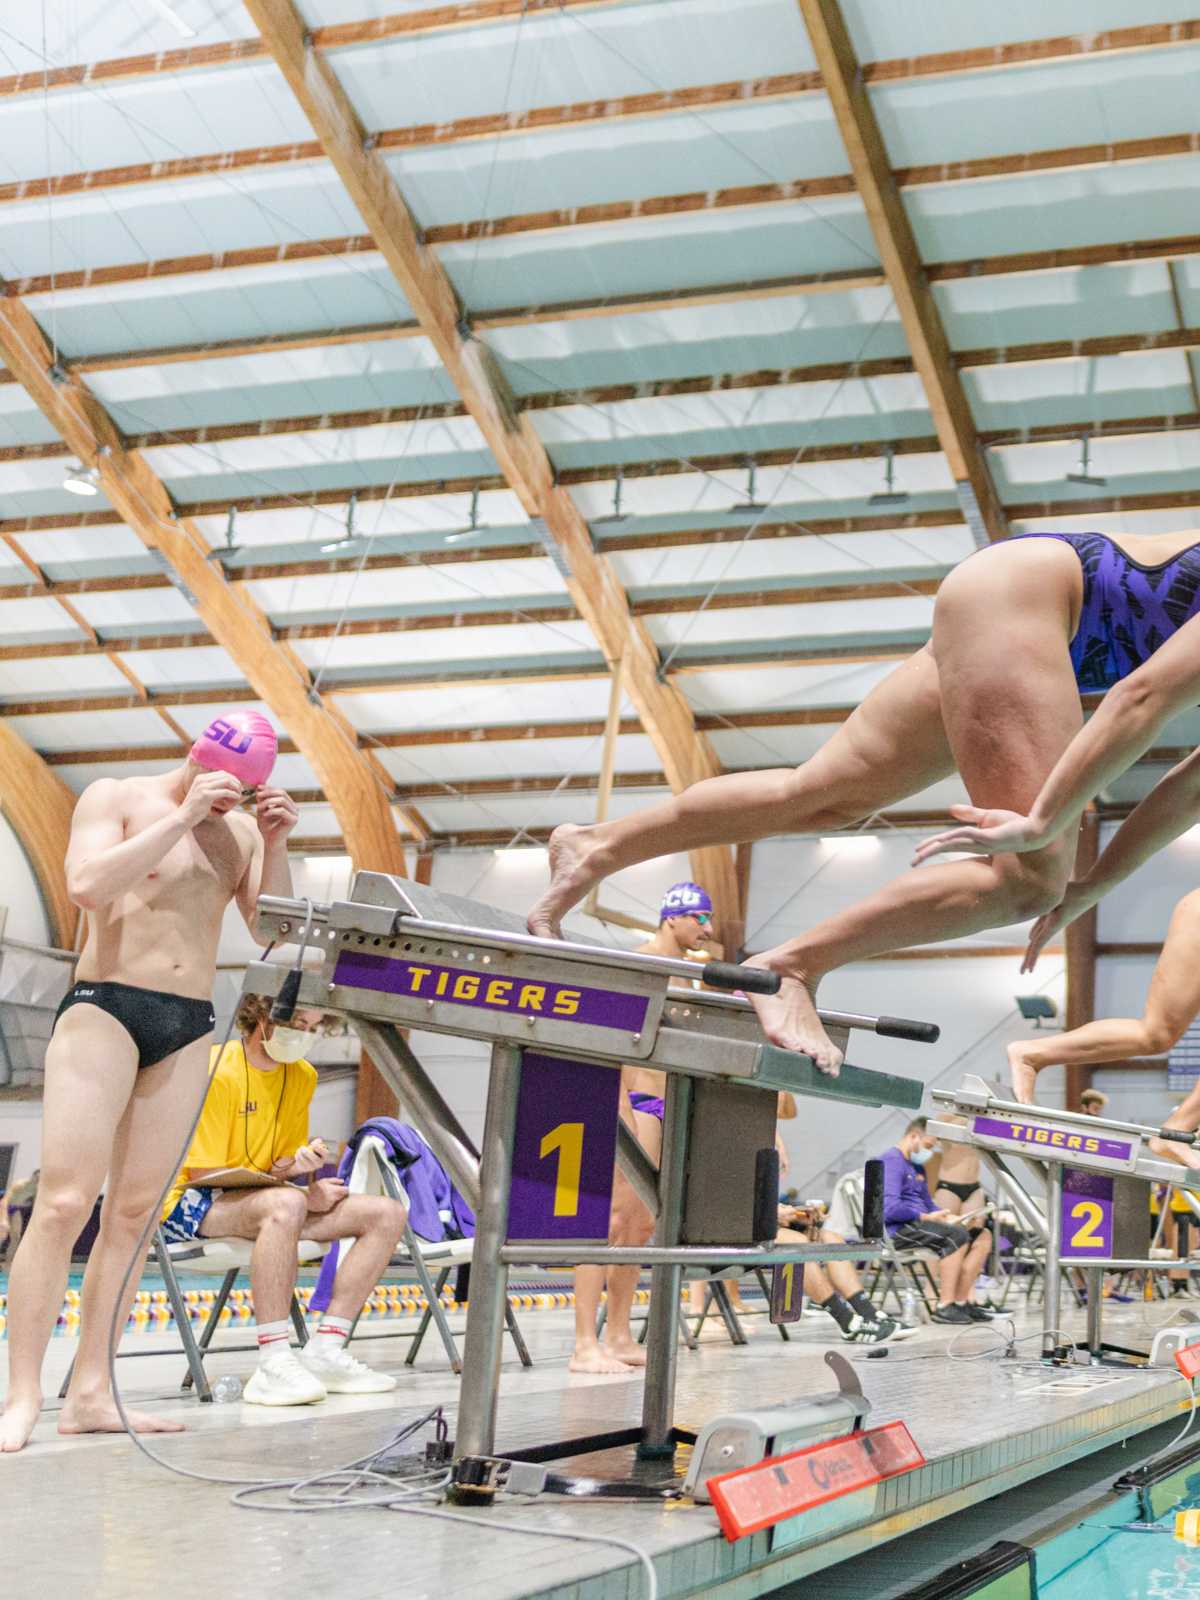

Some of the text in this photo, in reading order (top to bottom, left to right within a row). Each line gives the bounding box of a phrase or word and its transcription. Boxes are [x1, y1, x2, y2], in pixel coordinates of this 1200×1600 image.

[407, 966, 582, 1016] TIGERS
[1010, 1124, 1099, 1153] TIGERS
[540, 1123, 584, 1216] 1
[1071, 1201, 1104, 1248] 2
[782, 1262, 794, 1312] 1
